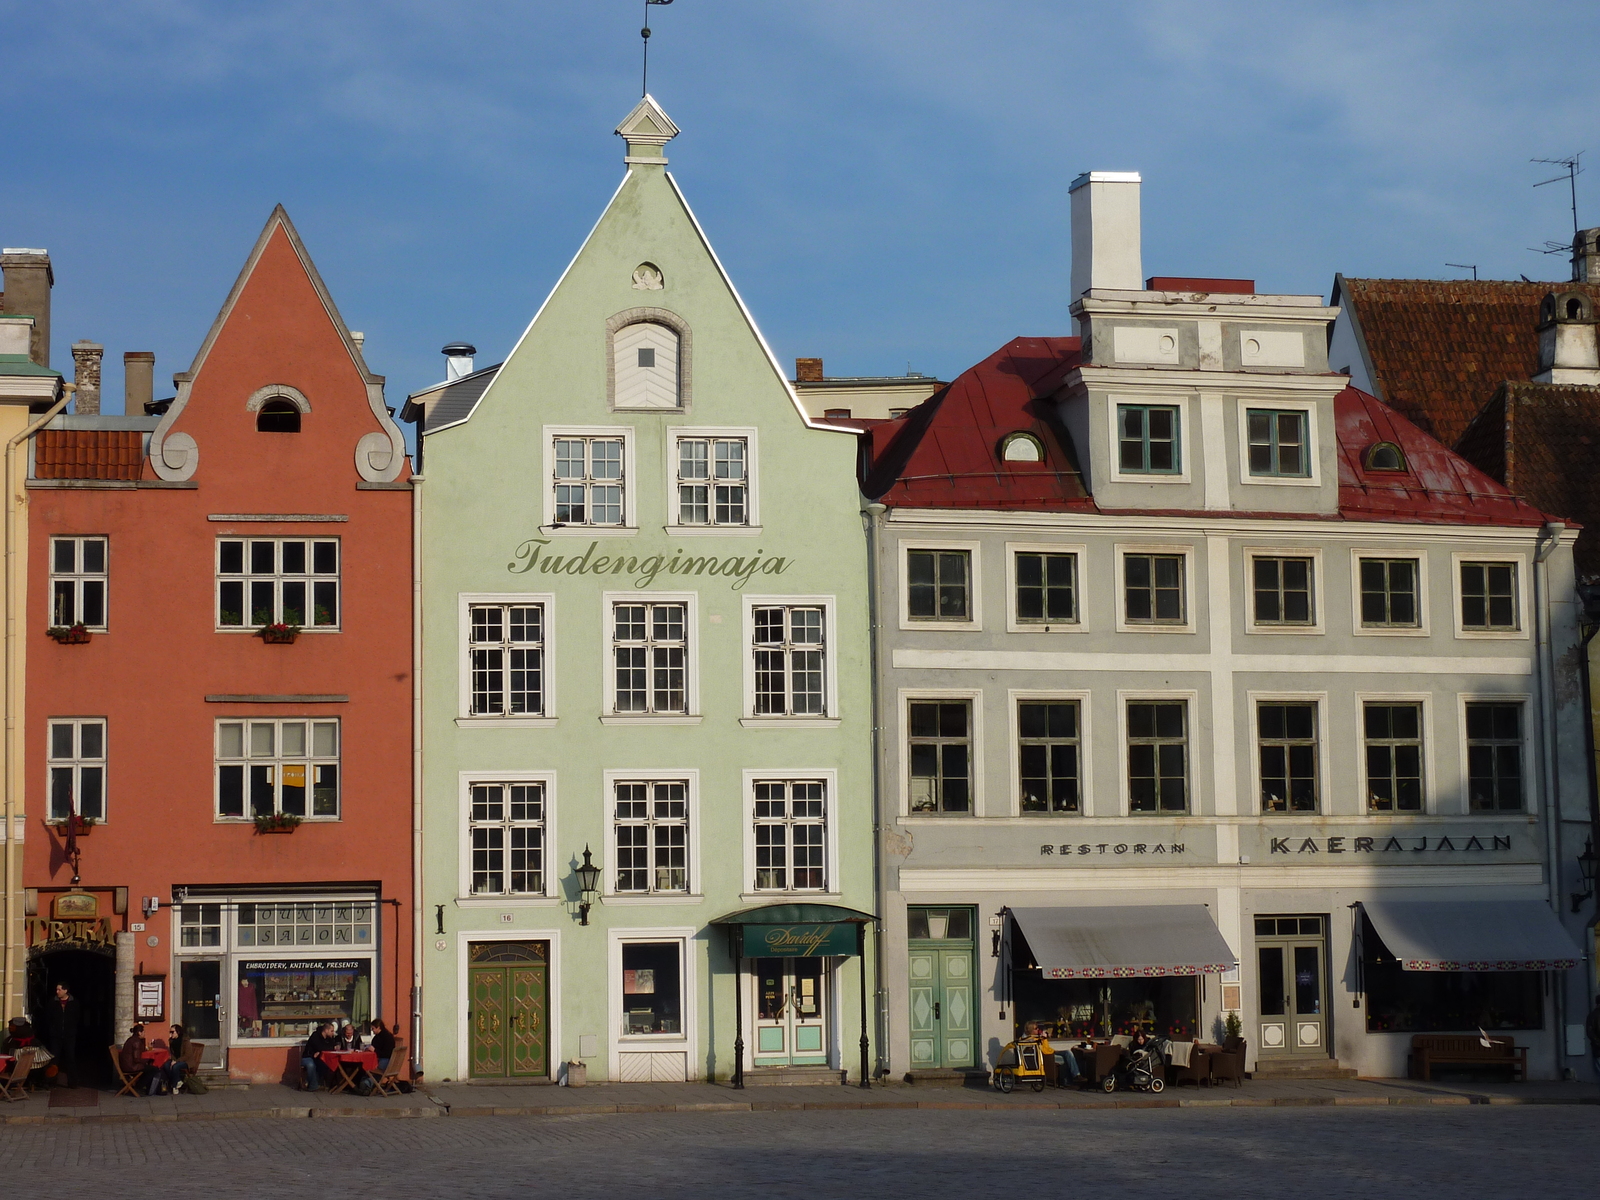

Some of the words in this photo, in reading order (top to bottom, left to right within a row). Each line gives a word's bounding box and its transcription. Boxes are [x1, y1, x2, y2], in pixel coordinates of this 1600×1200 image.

[507, 538, 796, 591] Tudengimaja
[1040, 842, 1185, 856] RESTORAN
[1270, 834, 1512, 855] KAERAJAAN
[242, 907, 368, 921] COUNTRY
[502, 914, 512, 922] 16
[25, 916, 117, 947] TROIKA
[261, 927, 350, 942] SALON
[764, 924, 836, 957] Davidoff
[245, 962, 288, 970] EMBROIDERY,
[289, 962, 325, 970] KNITWEAR,
[326, 961, 359, 969] PRESENTS
